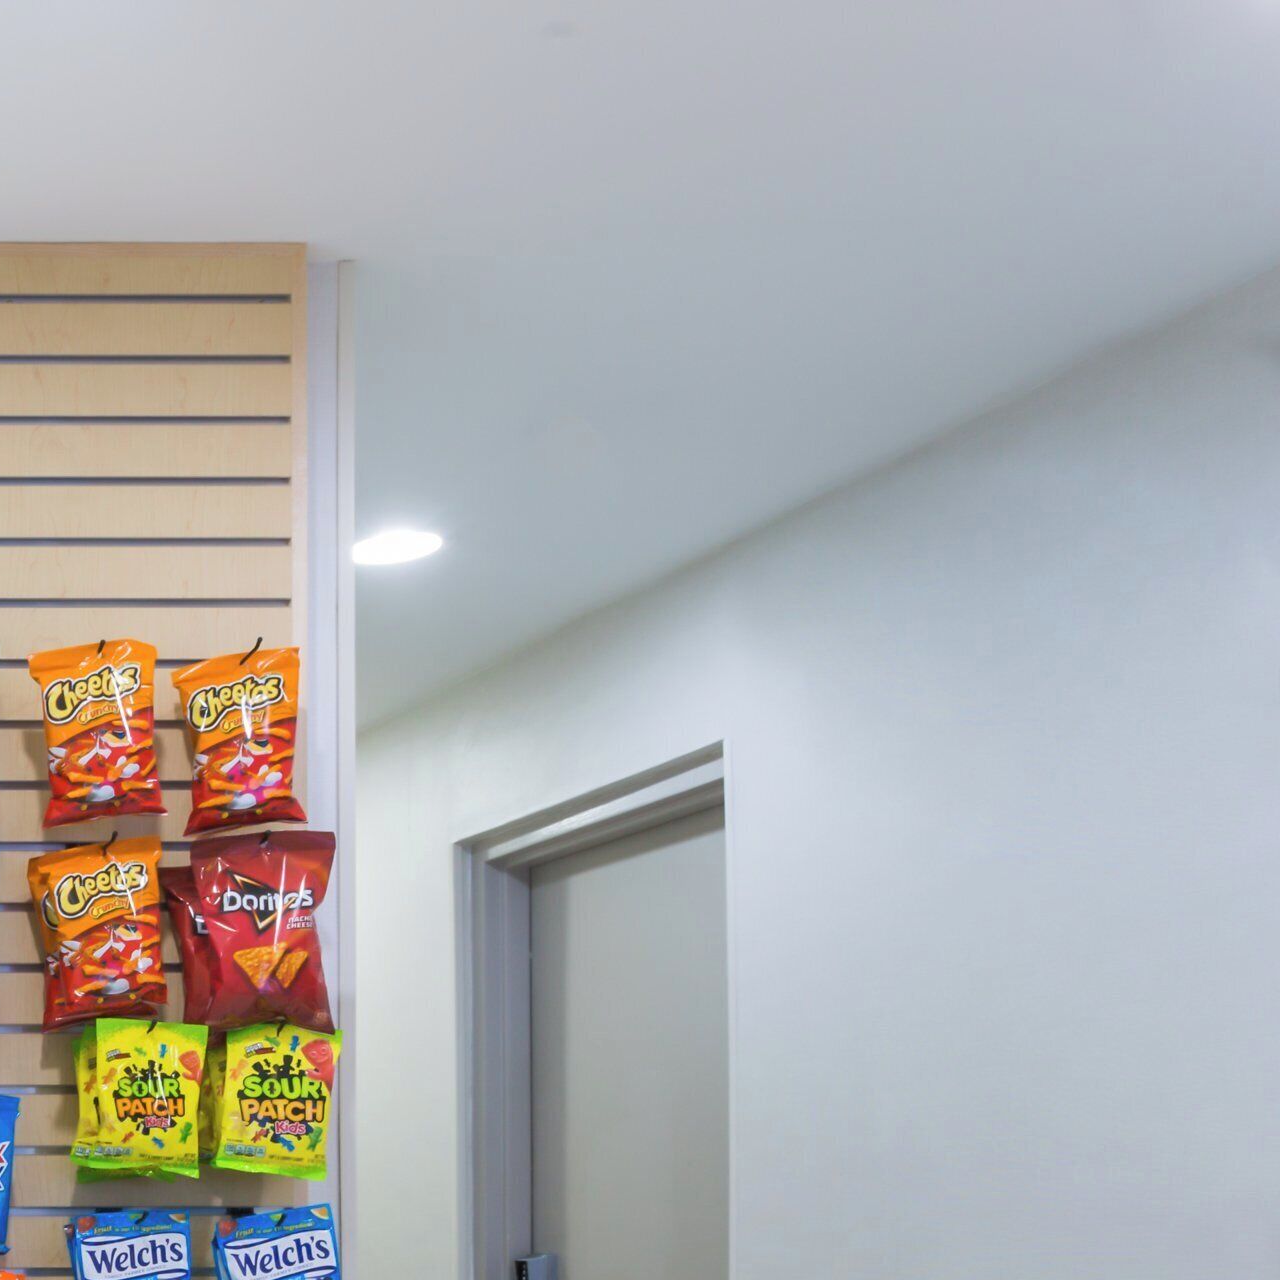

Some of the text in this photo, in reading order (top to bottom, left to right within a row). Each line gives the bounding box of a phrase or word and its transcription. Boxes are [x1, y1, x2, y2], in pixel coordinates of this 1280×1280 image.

[77, 703, 120, 726] Crunchy
[188, 676, 284, 730] Cheetos
[56, 863, 147, 918] Cheetos
[222, 888, 314, 912] Doritos
[91, 897, 131, 919] Crunchy
[117, 1076, 179, 1098] SOUR
[243, 1075, 322, 1099] SOUR
[116, 1097, 185, 1119] PATCH
[240, 1099, 324, 1122] PATCH
[145, 1116, 170, 1128] Kids
[275, 1120, 306, 1135] Kids
[86, 1238, 184, 1274] Welch's
[230, 1236, 330, 1277] Welch's
